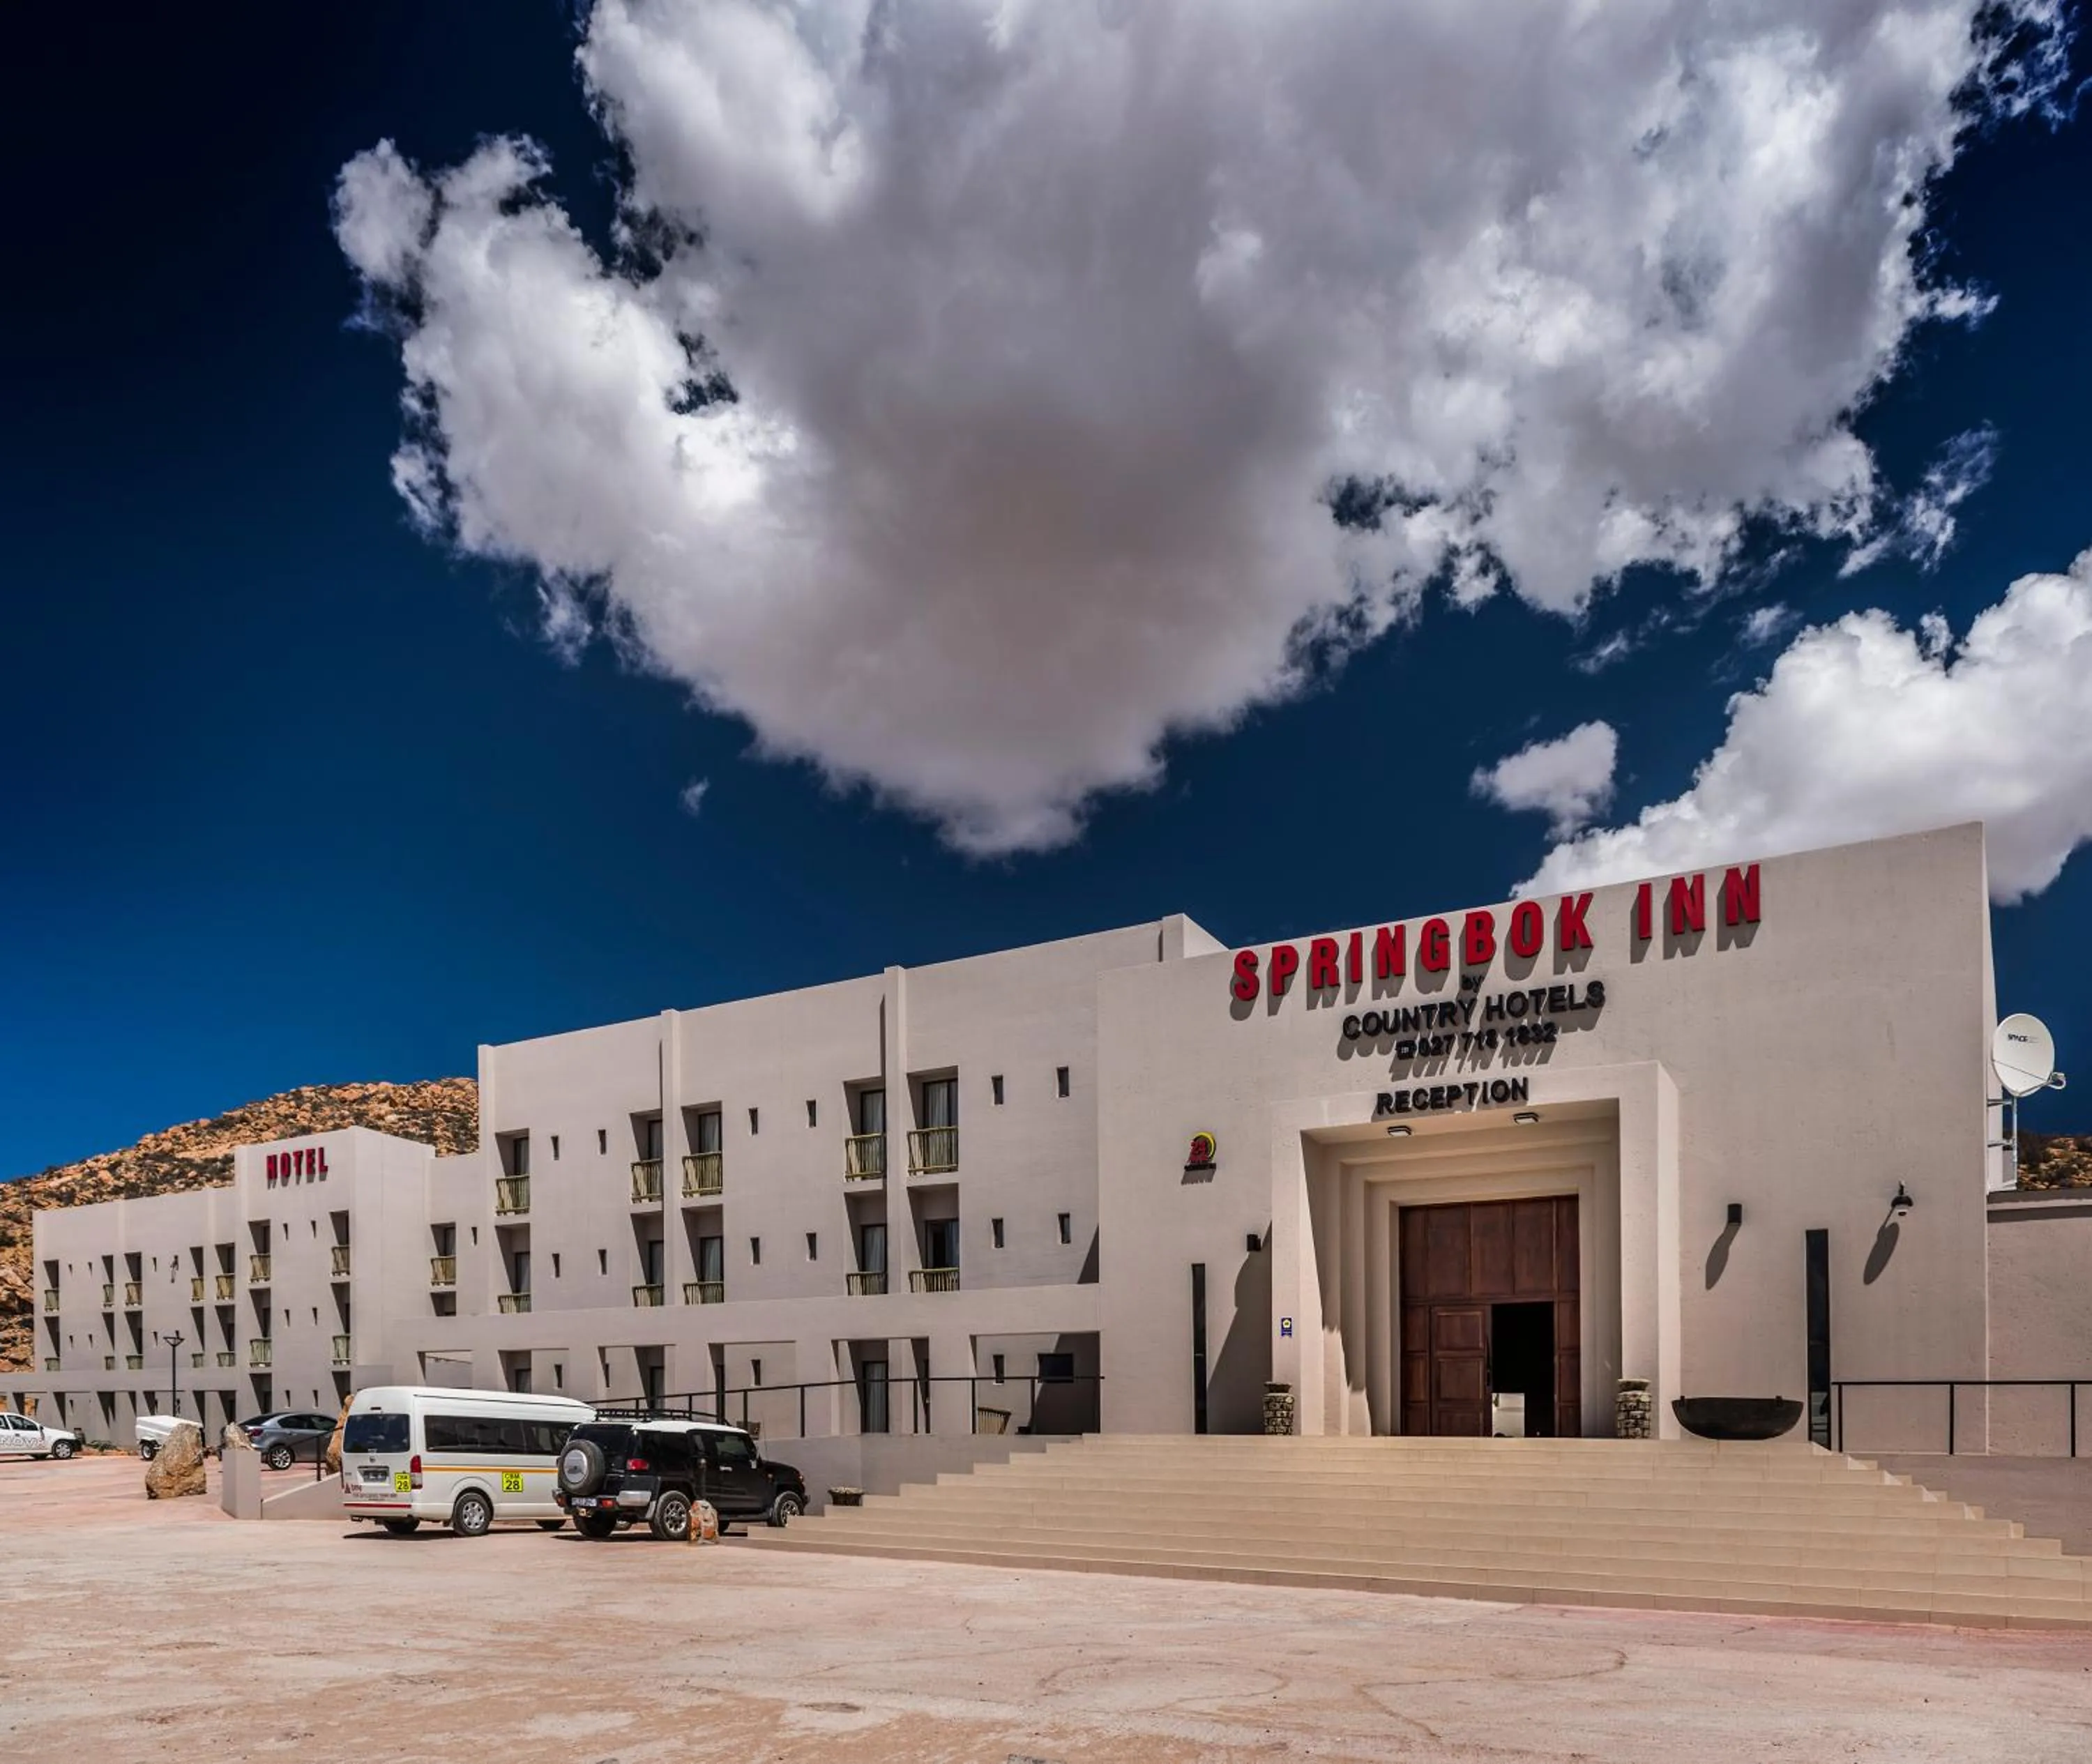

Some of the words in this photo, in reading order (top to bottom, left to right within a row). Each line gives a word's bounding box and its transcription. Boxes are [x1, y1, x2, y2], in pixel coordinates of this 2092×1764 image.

[1233, 891, 1594, 1001] SPRINGBOK
[1637, 863, 1761, 941] INN
[1342, 998, 1477, 1040] COUNTRY
[1485, 980, 1605, 1021] HOTELS
[1418, 1033, 1456, 1057] 027
[1376, 1076, 1529, 1116] RECEPTION
[266, 1147, 328, 1180] HOTEL
[397, 1481, 409, 1490] 28
[506, 1480, 520, 1490] 28
